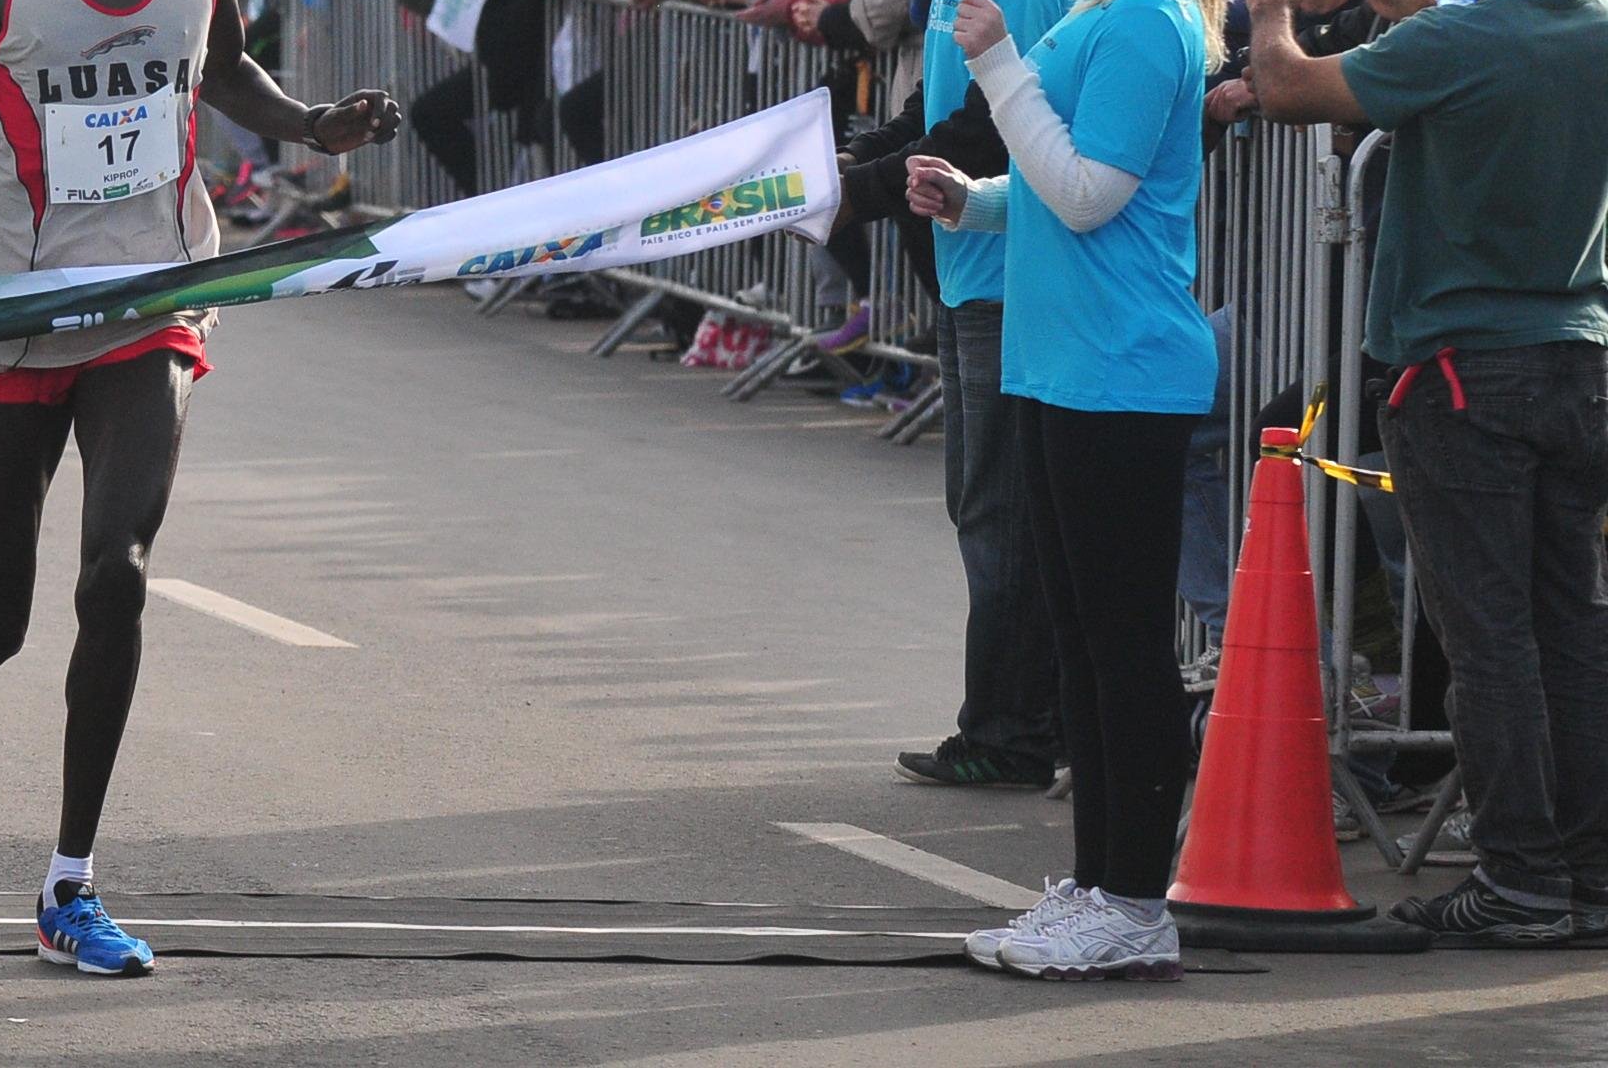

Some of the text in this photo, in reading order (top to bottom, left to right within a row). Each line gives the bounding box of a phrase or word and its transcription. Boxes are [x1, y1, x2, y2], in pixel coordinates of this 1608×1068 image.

[37, 59, 190, 104] LUASA
[85, 105, 148, 129] CAIXA
[98, 130, 141, 166] 17
[103, 168, 139, 183] KIPROP
[67, 189, 101, 201] FILA
[641, 173, 807, 238] BRASIL
[667, 231, 692, 241] RICO
[733, 219, 754, 229] SEM
[758, 207, 807, 223] POBREZA
[457, 233, 603, 276] CAIXA
